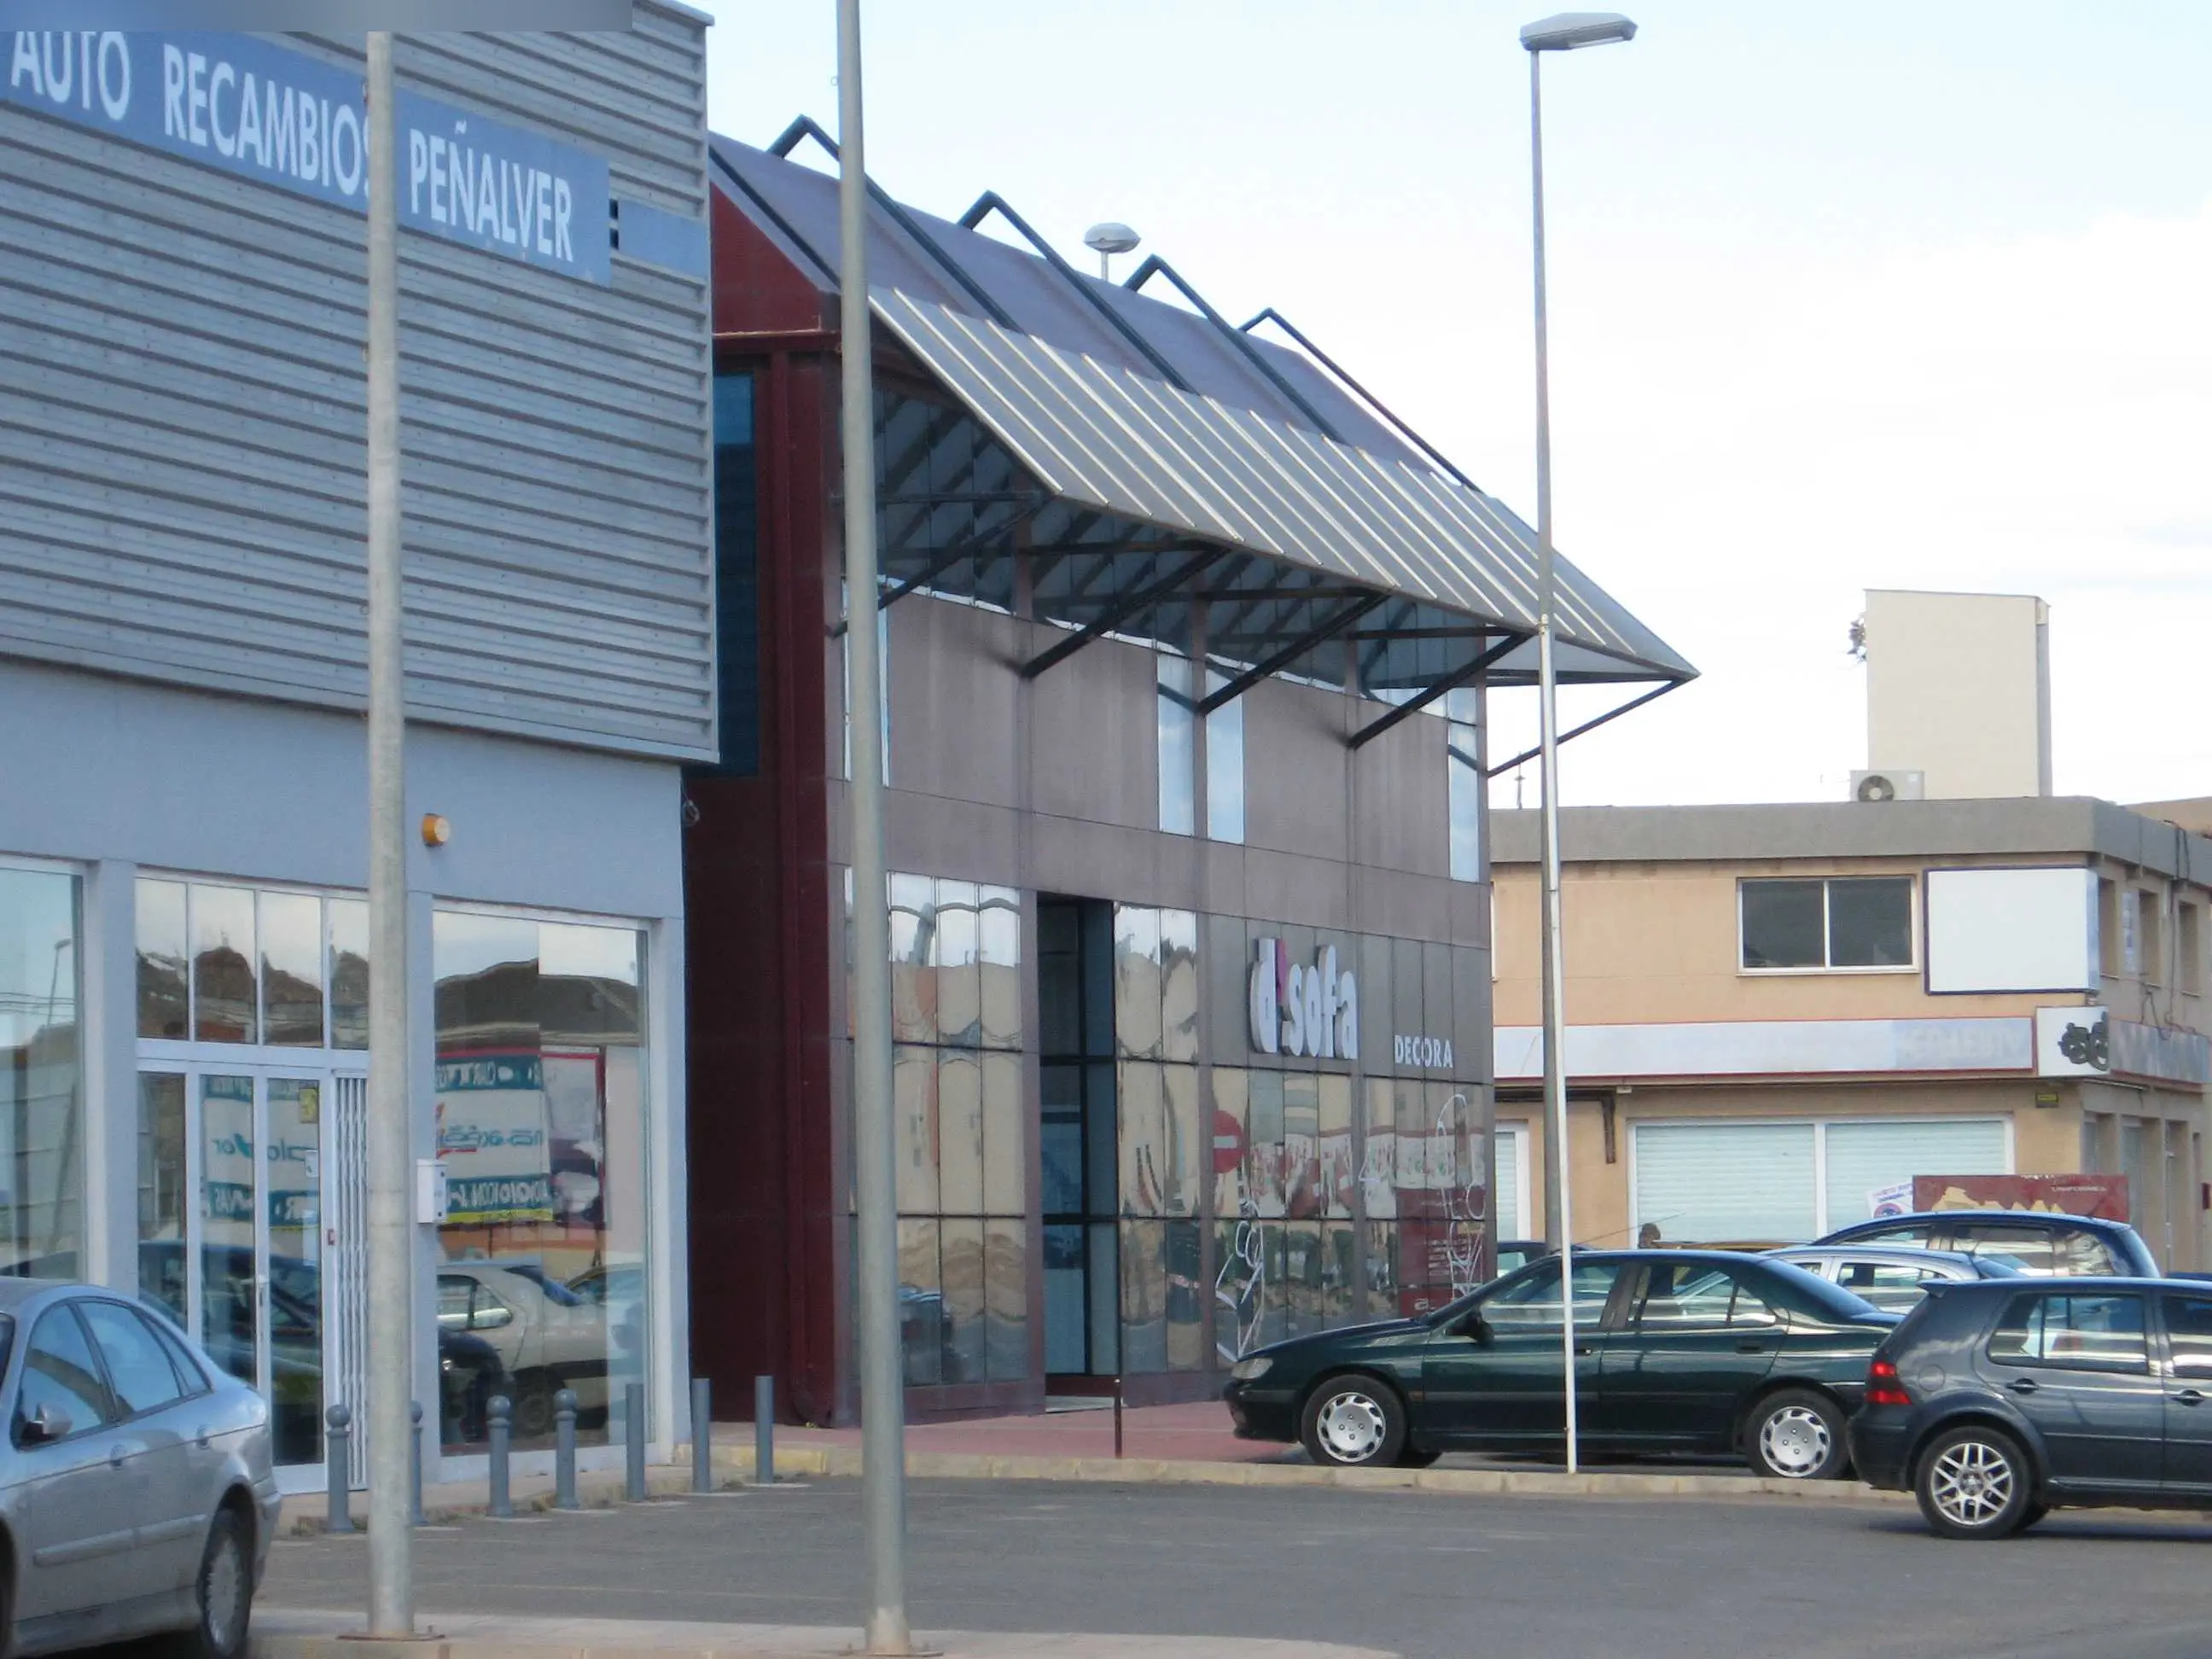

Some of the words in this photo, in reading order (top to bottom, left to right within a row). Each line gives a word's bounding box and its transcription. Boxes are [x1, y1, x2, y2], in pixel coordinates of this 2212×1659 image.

[11, 32, 131, 121] AUTO
[410, 119, 573, 263] PEÑALVER
[1394, 1034, 1454, 1068] DECORA
